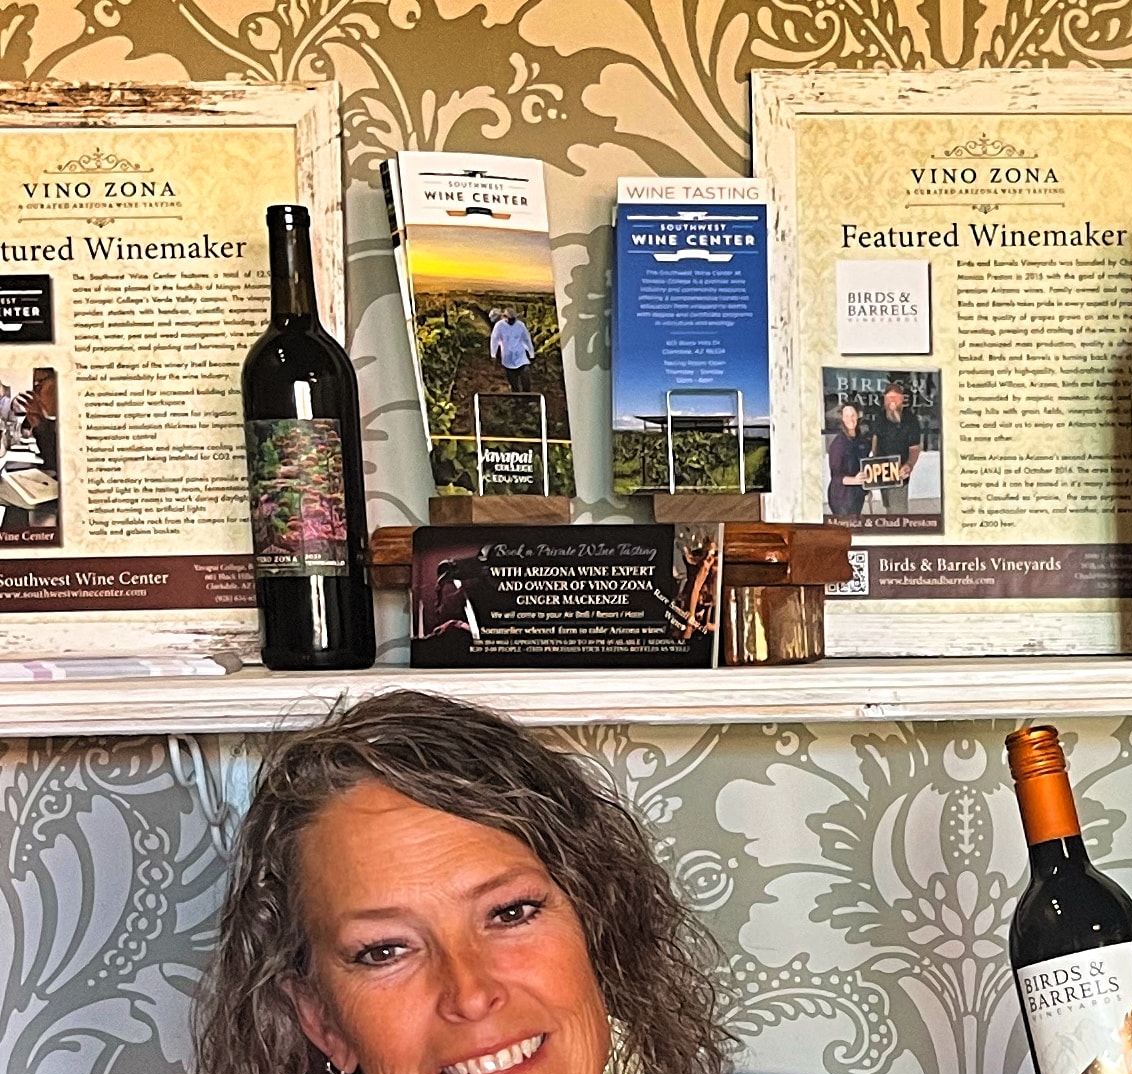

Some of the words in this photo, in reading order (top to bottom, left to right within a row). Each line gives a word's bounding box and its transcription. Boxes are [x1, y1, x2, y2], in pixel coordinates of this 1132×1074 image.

[911, 168, 976, 184] VINO
[990, 167, 1058, 184] ZONA
[23, 182, 90, 198] VINO
[105, 182, 175, 197] ZONA
[449, 181, 503, 190] SOUTHWEST
[627, 187, 675, 199] WINE
[682, 187, 759, 199] TASTING
[424, 191, 463, 201] WINE
[473, 193, 528, 206] CENTER
[632, 235, 677, 245] WINE
[686, 235, 755, 245] CENTER
[841, 223, 959, 249] Featured
[969, 222, 1127, 248] Winemaker
[1, 236, 74, 262] tured
[84, 234, 247, 260] Winemaker
[848, 292, 895, 303] BIRDS
[899, 292, 910, 303] &
[0, 307, 40, 316] NTER
[848, 305, 918, 316] BARRELS
[838, 392, 934, 408] BARELS
[863, 462, 900, 484] OPEN
[865, 518, 873, 527] &
[875, 517, 900, 527] Chad
[902, 517, 937, 527] Preston
[22, 531, 54, 540] Center
[617, 543, 657, 561] Tasting
[490, 566, 522, 577] WITH
[524, 566, 575, 577] ARIZONA
[578, 566, 608, 576] WINE
[611, 566, 656, 576] EXPERT
[879, 558, 916, 572] Birds
[920, 559, 933, 572] &
[937, 557, 986, 572] Barrels
[989, 556, 1062, 571] Vineyards
[0, 572, 70, 587] Southwest
[75, 572, 114, 585] Wine
[119, 571, 168, 585] Center
[498, 581, 522, 591] AND
[525, 580, 568, 591] OWNER
[570, 580, 587, 590] OF
[588, 580, 617, 591] VINO
[620, 580, 653, 590] ZONA
[516, 594, 560, 605] GINGER
[562, 594, 629, 605] MACKENZIE
[654, 589, 669, 604] Rare
[609, 626, 639, 634] Arizona
[1024, 964, 1082, 994] BIRDS
[1089, 960, 1105, 978] &
[1029, 975, 1120, 1013] BARRELS
[1031, 995, 1122, 1022] VINEYARDS
